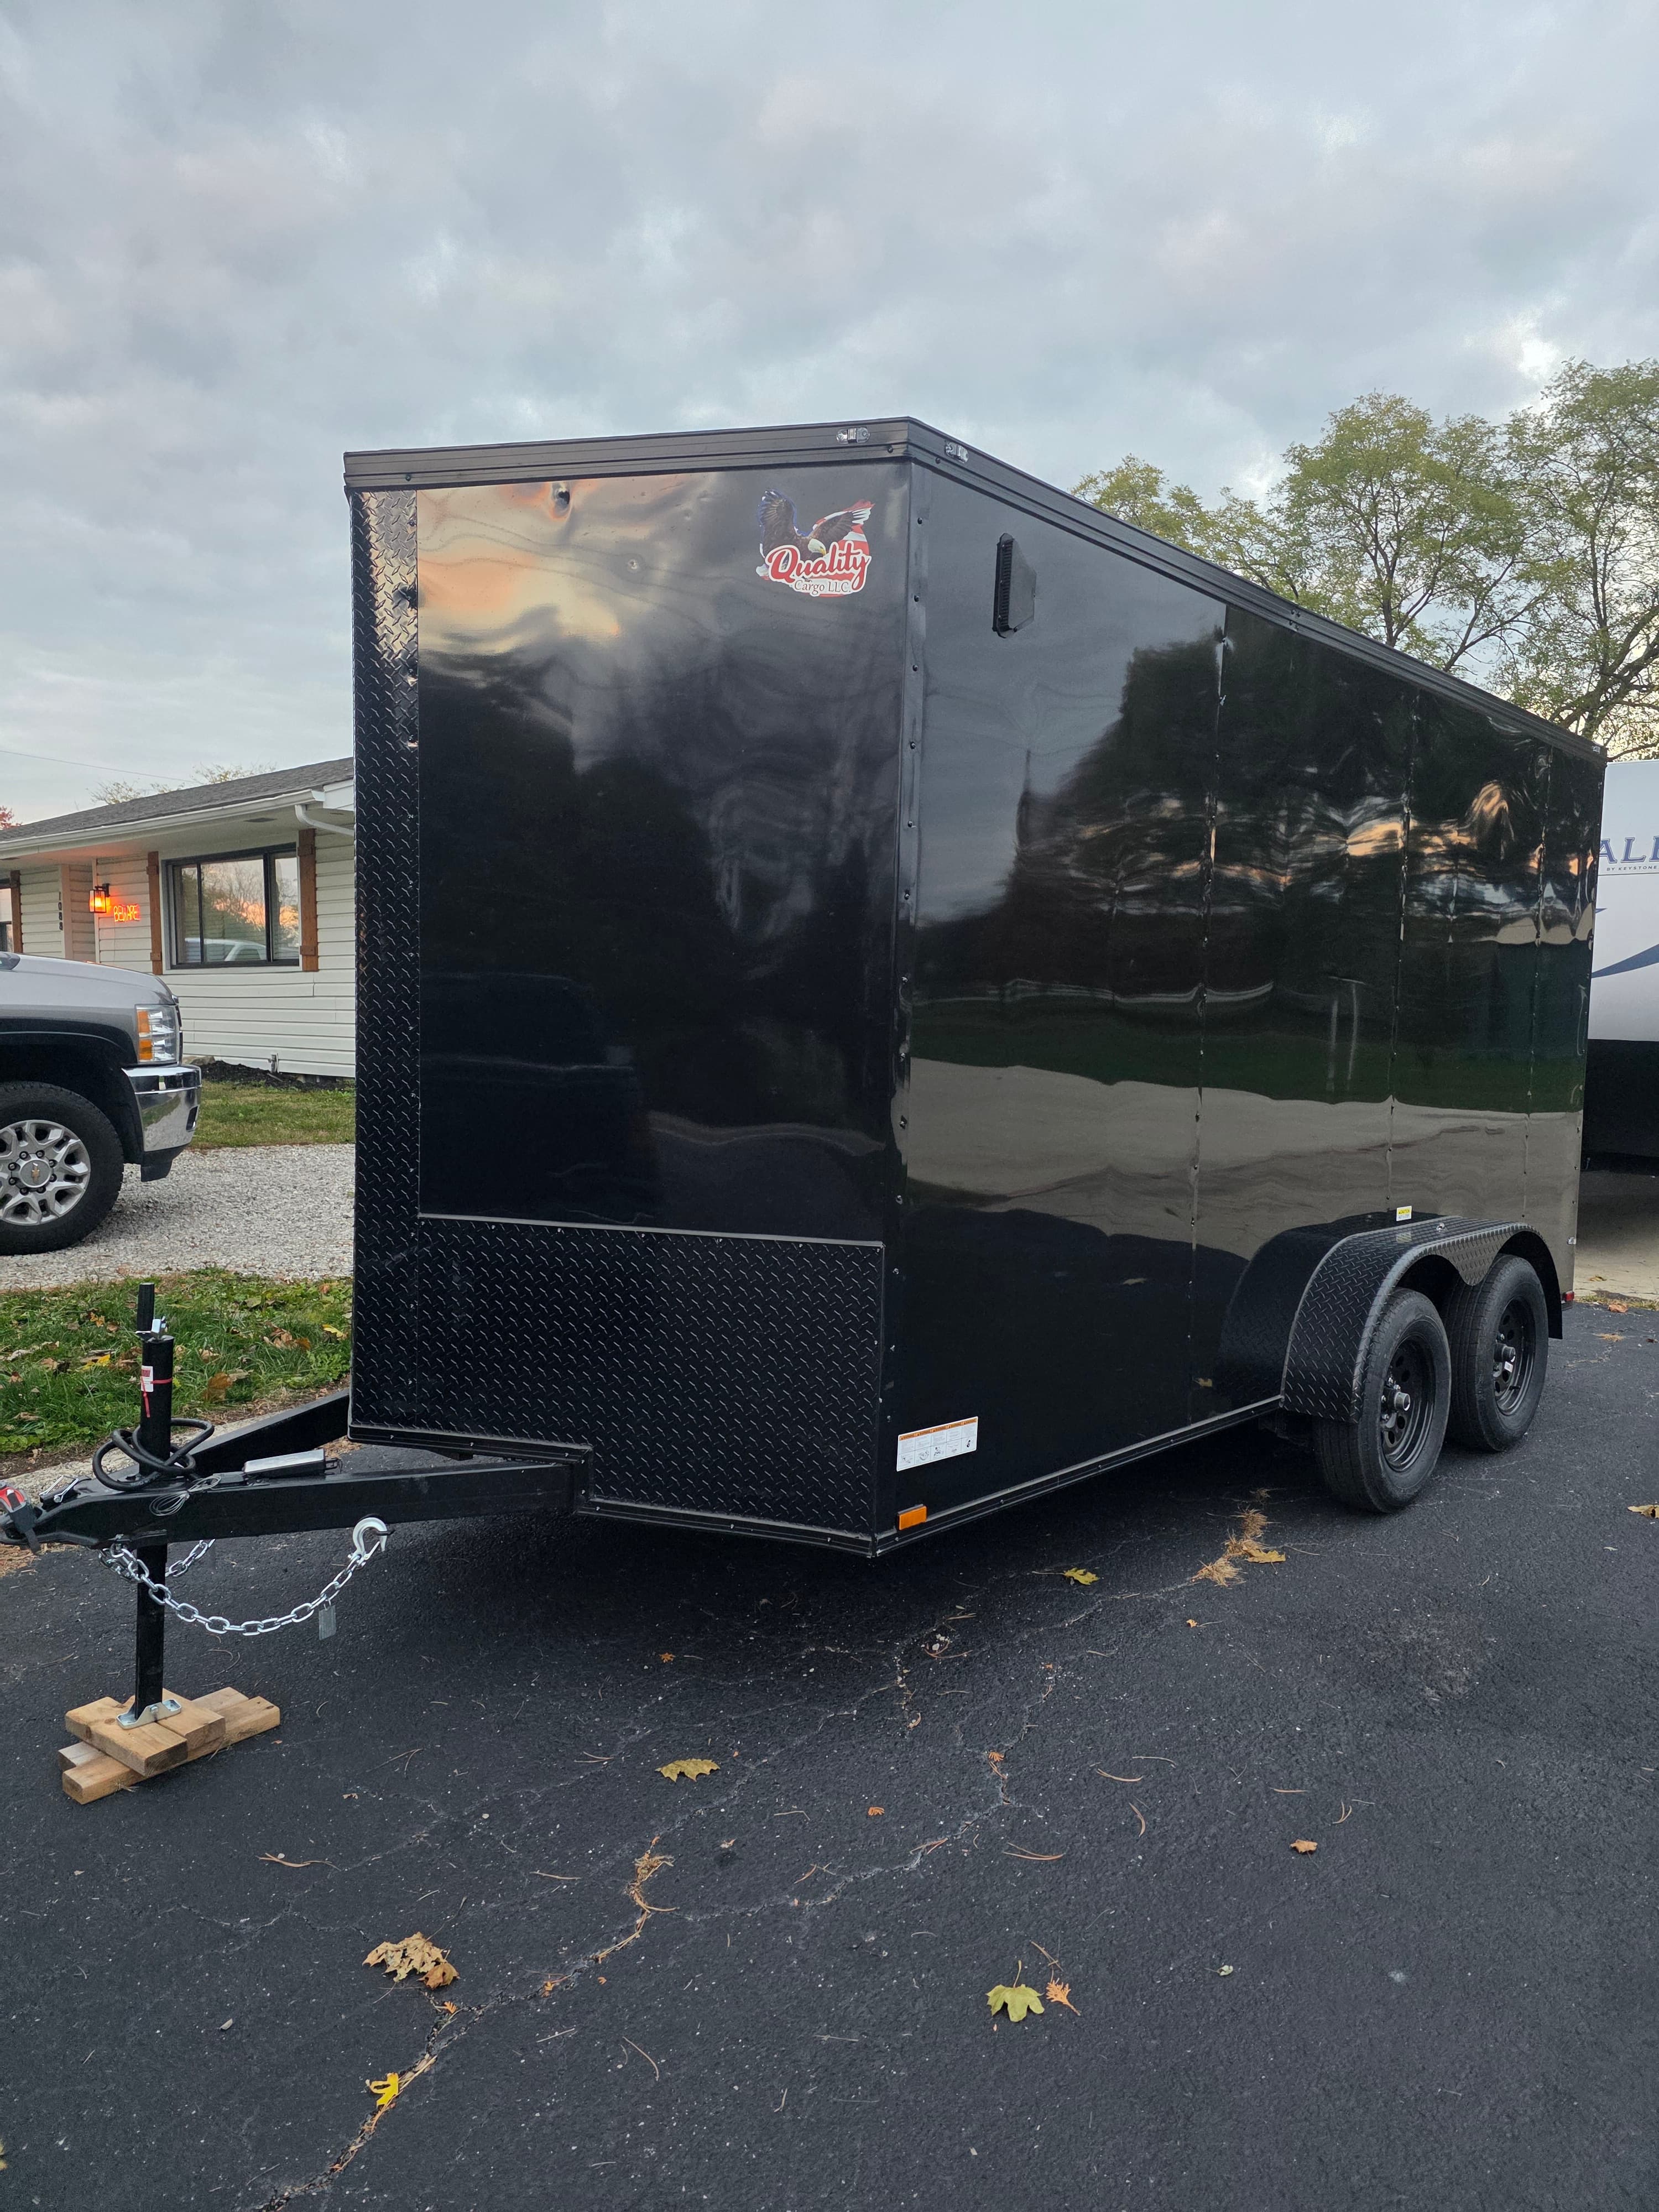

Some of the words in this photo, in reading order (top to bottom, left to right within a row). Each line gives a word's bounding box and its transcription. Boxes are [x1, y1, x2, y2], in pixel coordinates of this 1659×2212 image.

[766, 541, 871, 591] Quality
[794, 580, 825, 595] Cargo
[113, 905, 140, 922] BEWARE
